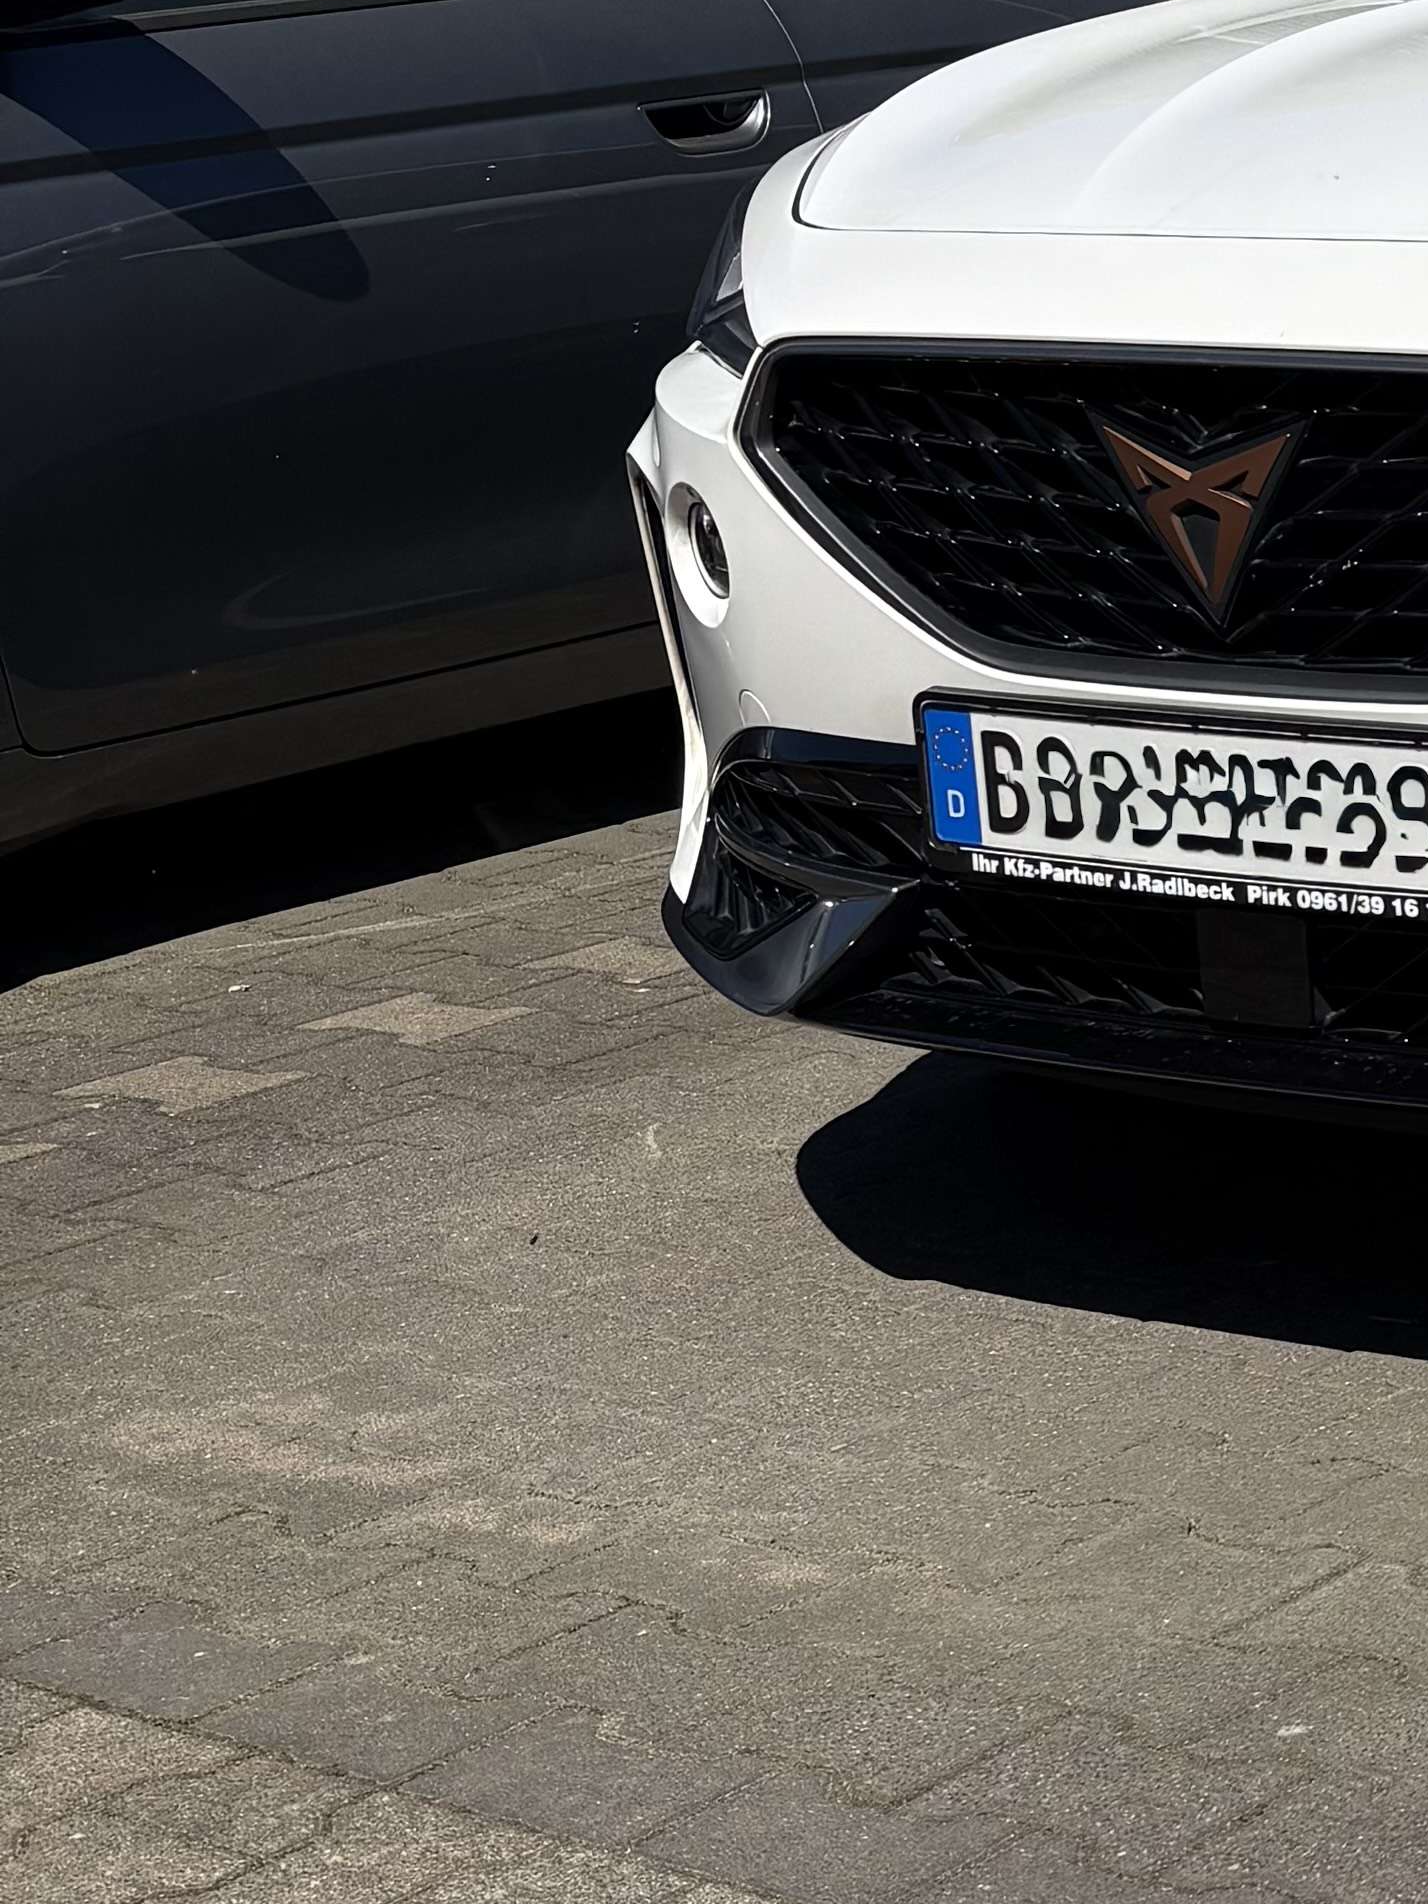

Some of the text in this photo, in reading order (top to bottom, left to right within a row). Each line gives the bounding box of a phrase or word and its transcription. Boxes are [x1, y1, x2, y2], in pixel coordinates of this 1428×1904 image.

[946, 788, 966, 818] D
[972, 852, 999, 873] Ihr
[1003, 856, 1114, 888] Kfz-Partner
[1119, 871, 1236, 902] J.Radlbeck
[1247, 884, 1292, 908] Pirk
[1296, 889, 1385, 916] 0961/39
[1392, 898, 1420, 918] 16
